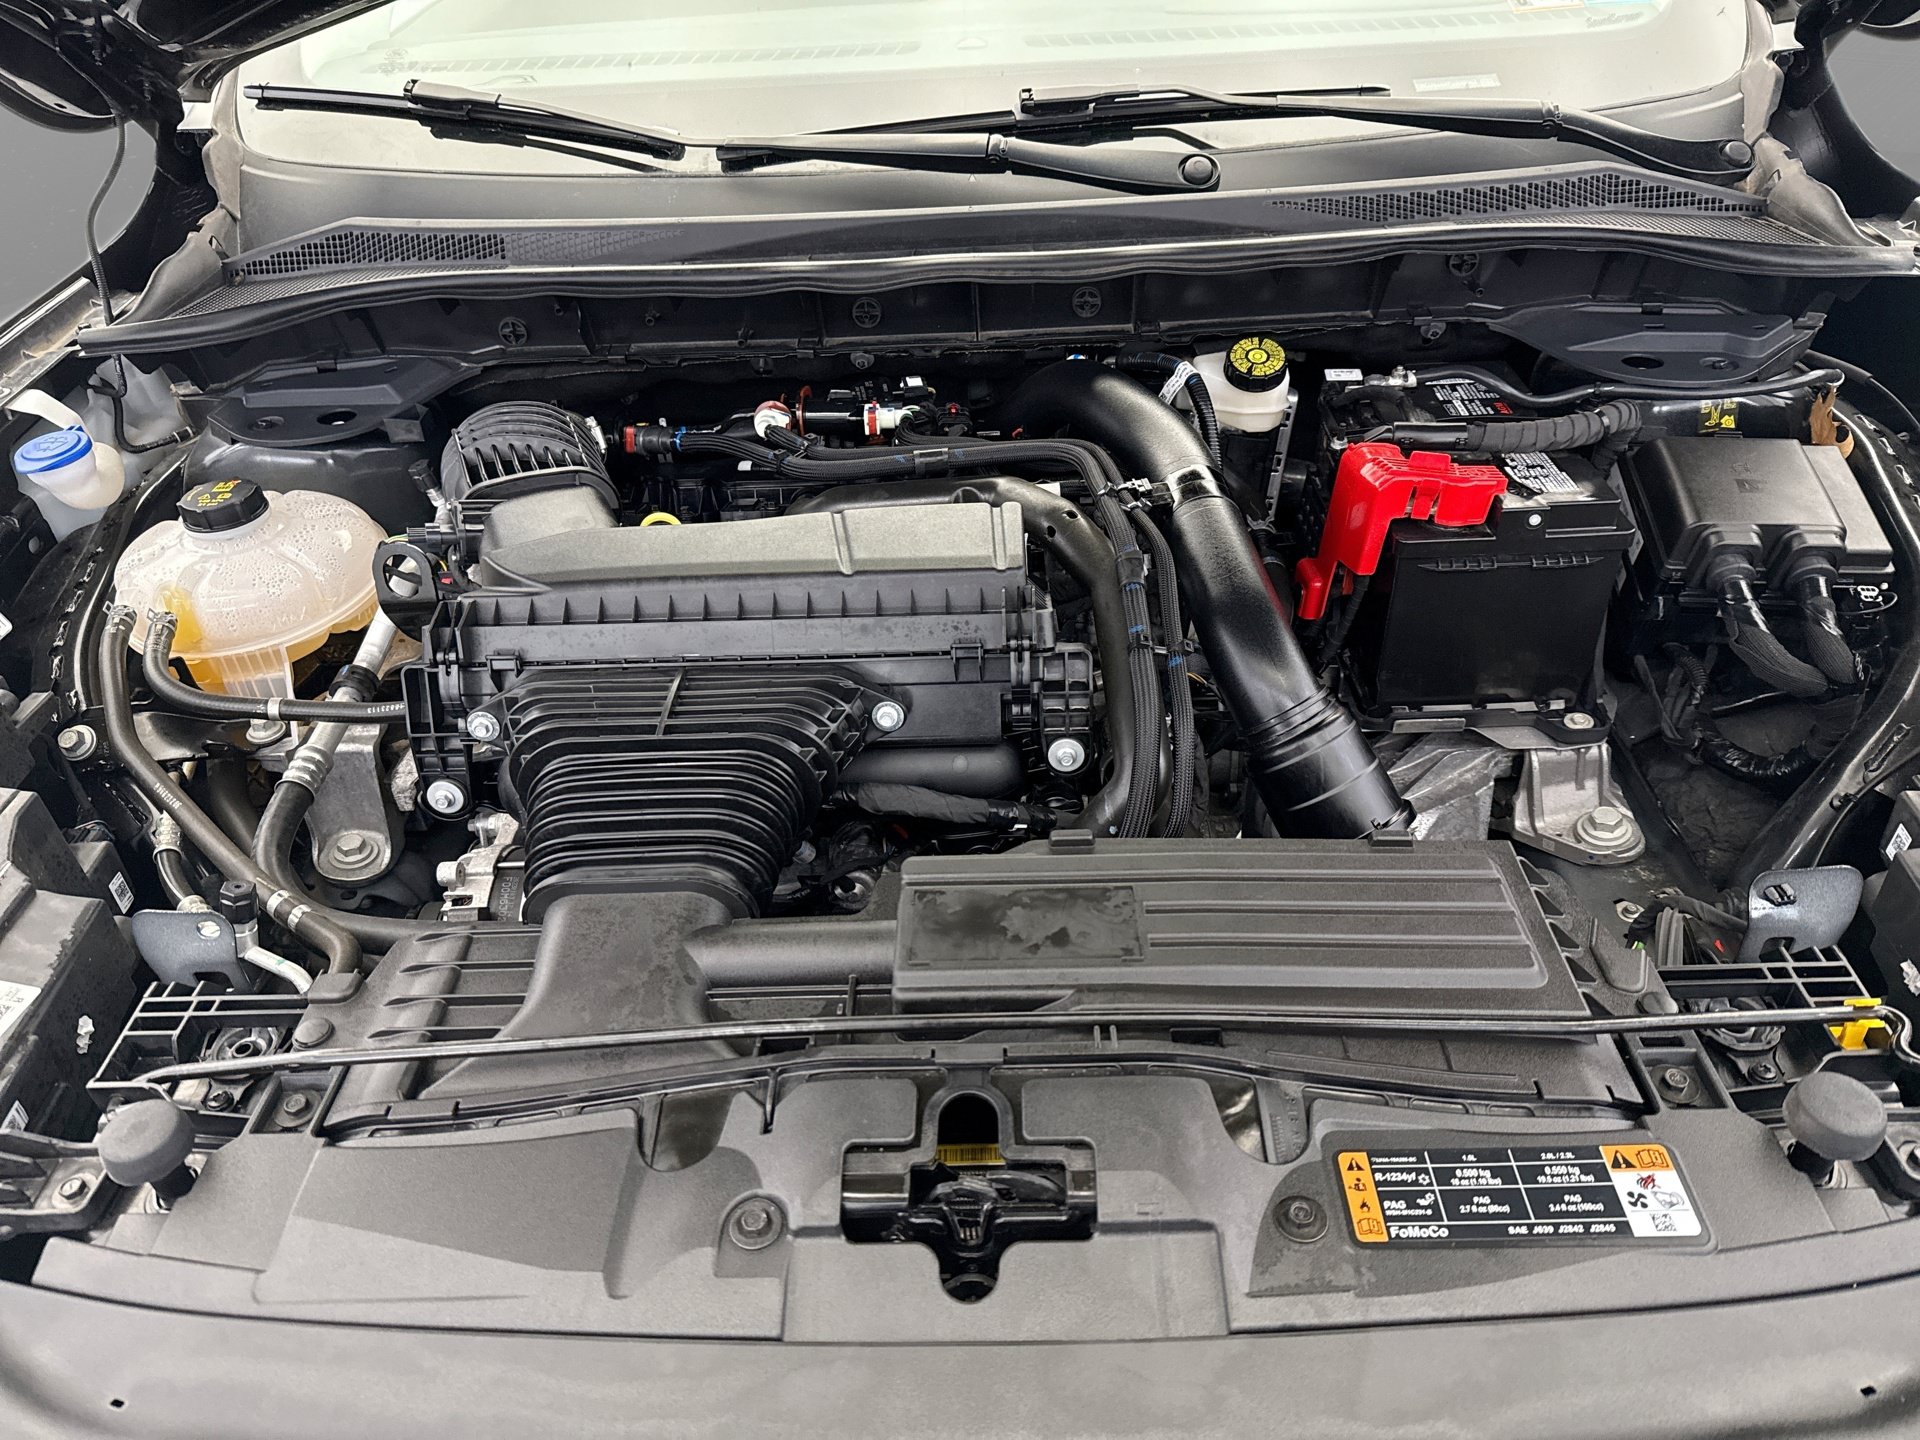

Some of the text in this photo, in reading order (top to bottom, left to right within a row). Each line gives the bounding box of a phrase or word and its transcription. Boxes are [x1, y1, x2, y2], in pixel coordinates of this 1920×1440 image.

[1455, 1168, 1491, 1179] 0.500 kg
[1544, 1164, 1580, 1176] 0.550 kg
[1472, 1195, 1491, 1204] PAG
[1563, 1193, 1582, 1203] PAG
[1383, 1200, 1407, 1210] PAG
[1389, 1225, 1449, 1239] FoMoCo
[1507, 1225, 1529, 1235] SAE
